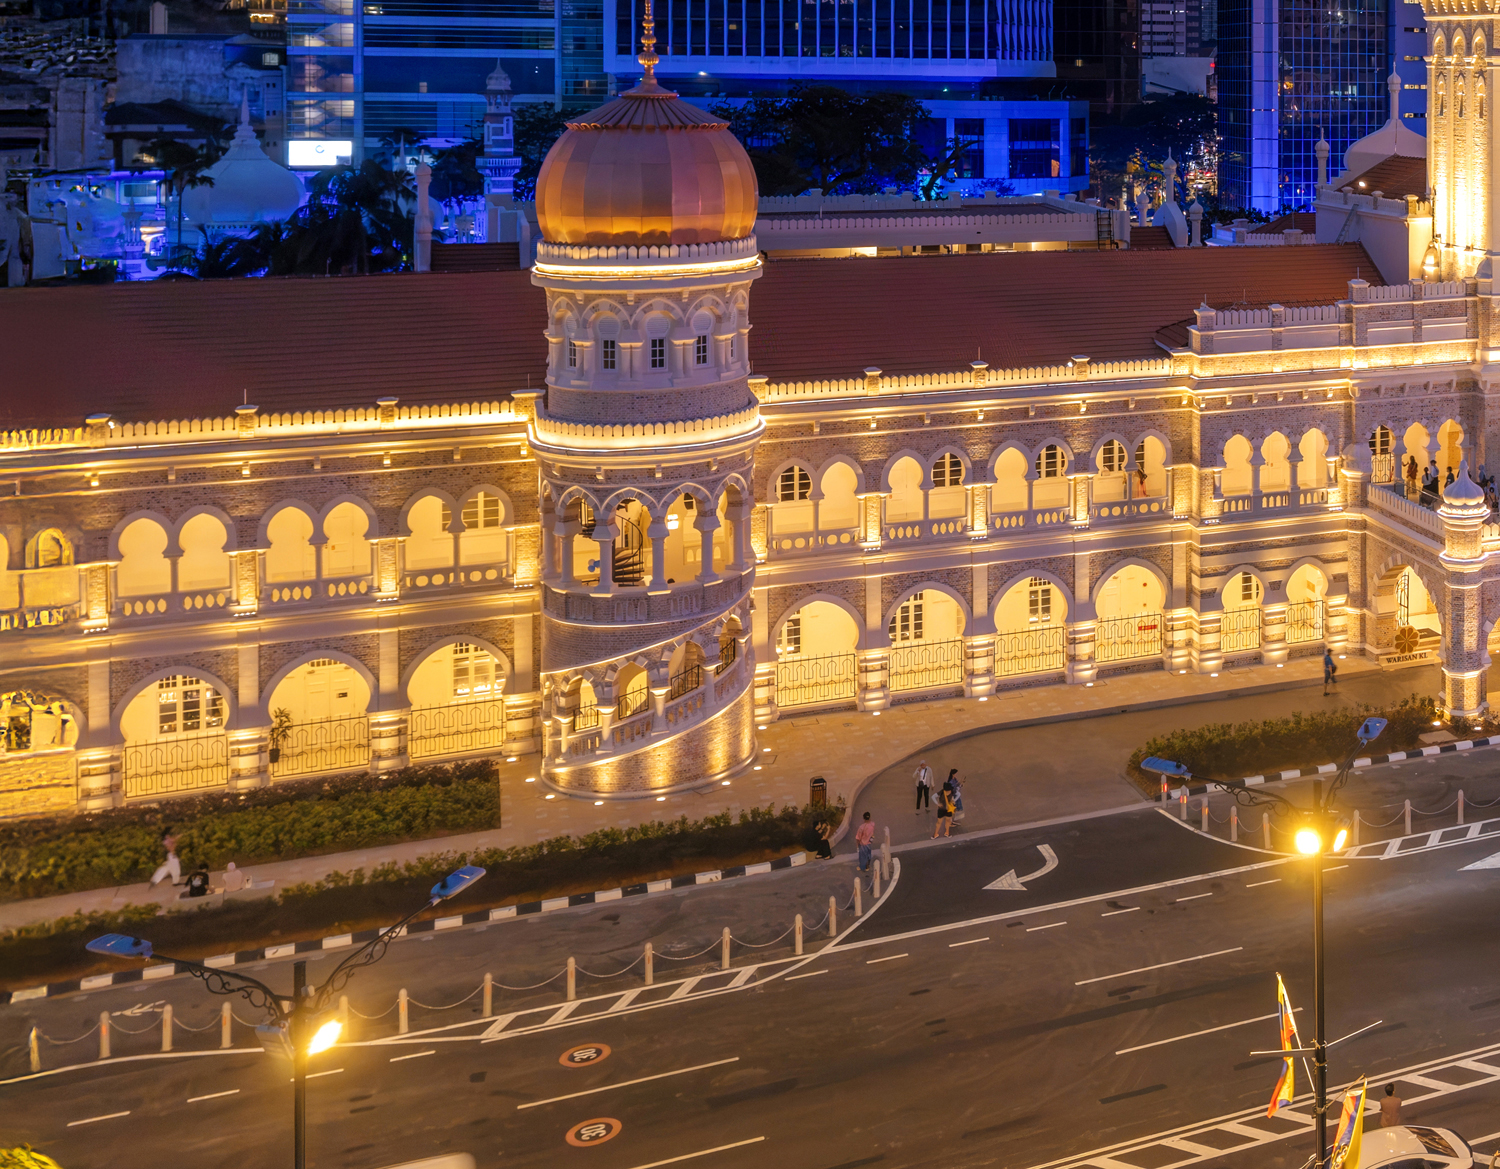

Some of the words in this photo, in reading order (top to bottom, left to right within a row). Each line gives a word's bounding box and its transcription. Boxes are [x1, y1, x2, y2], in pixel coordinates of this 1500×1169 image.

[1386, 653, 1418, 664] WARISAN
[1418, 652, 1428, 660] KL
[573, 1048, 597, 1062] 30
[580, 1123, 607, 1141] 30
